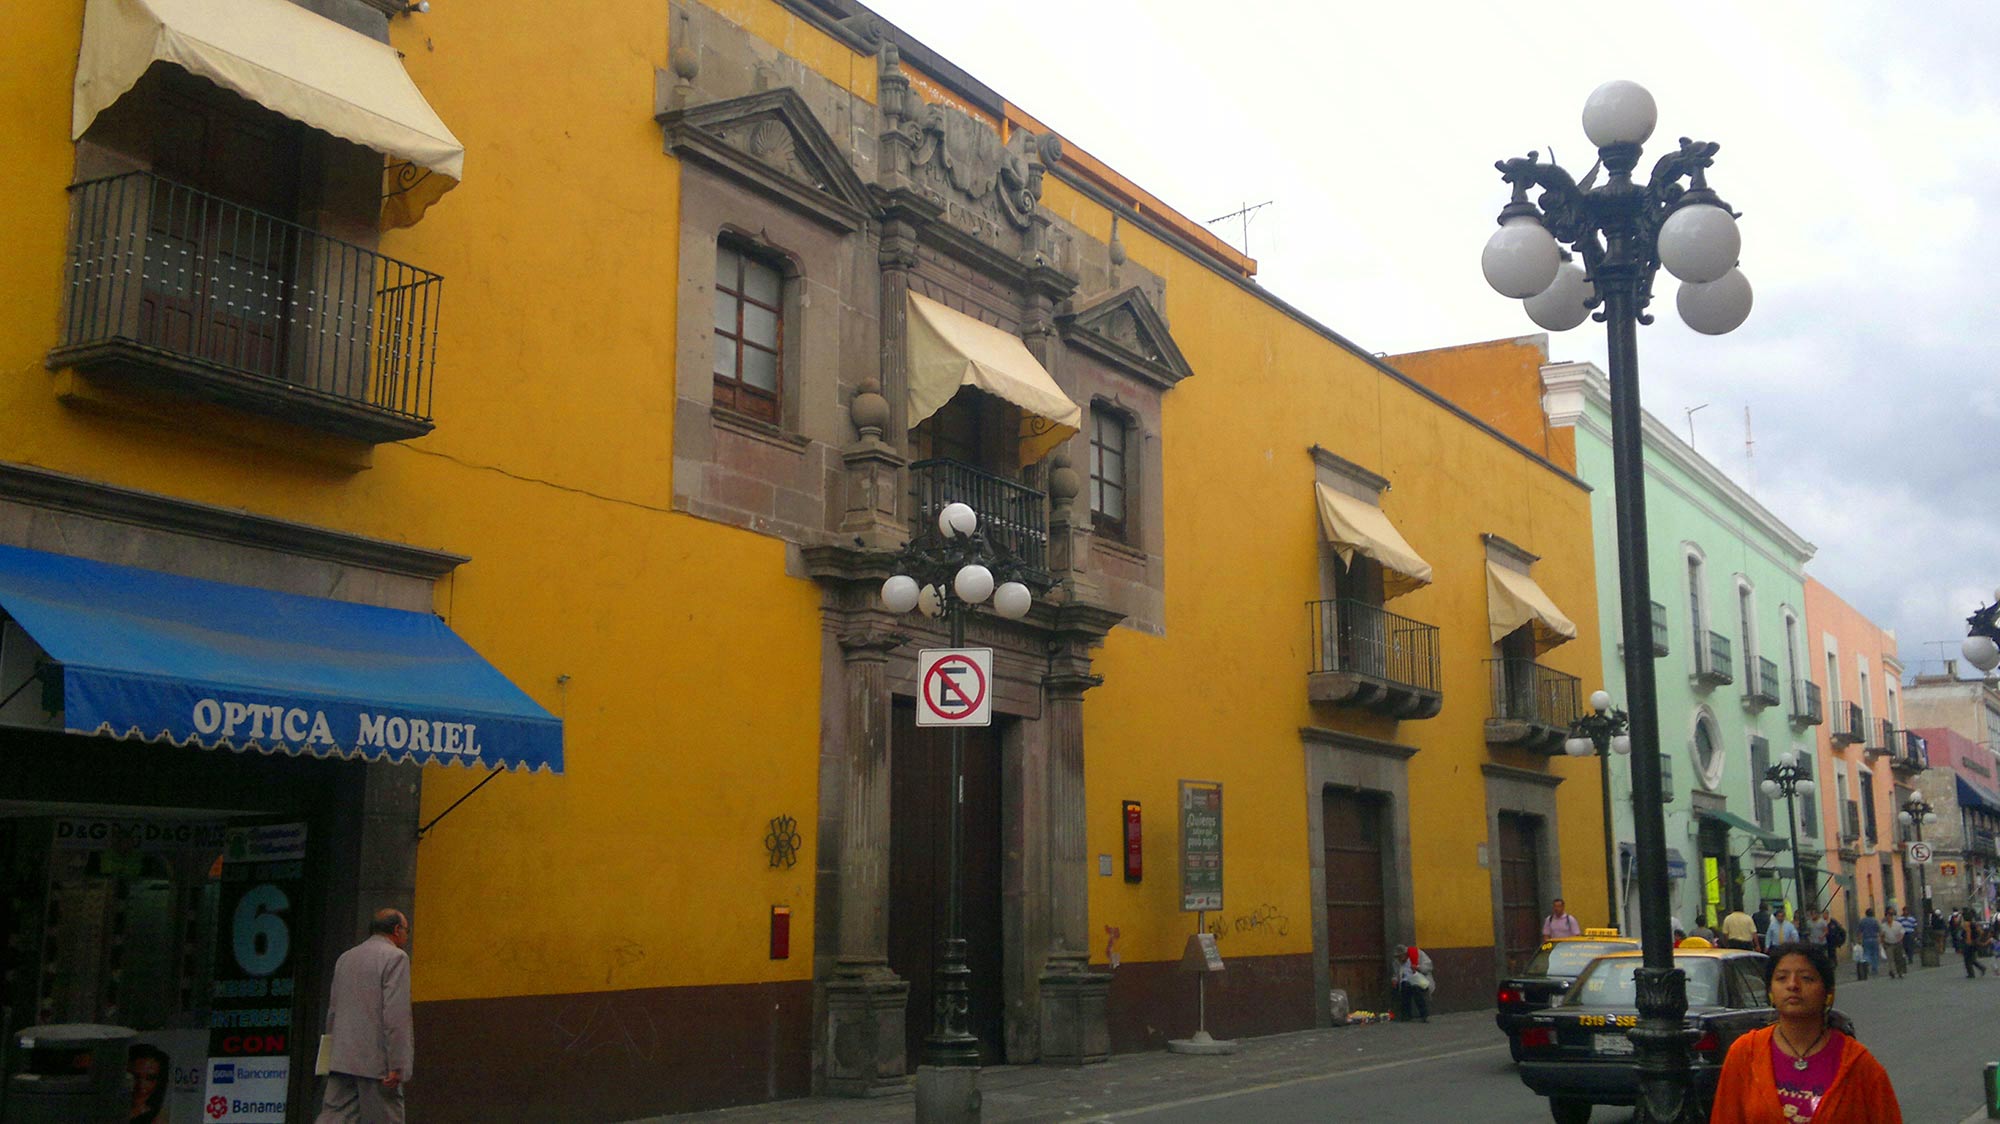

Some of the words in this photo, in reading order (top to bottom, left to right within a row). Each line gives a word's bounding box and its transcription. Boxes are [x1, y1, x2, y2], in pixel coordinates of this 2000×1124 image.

[940, 667, 967, 707] E
[193, 698, 336, 745] OPTICA
[356, 713, 481, 756] MORIEL
[232, 883, 290, 975] 6
[223, 1033, 286, 1054] CON
